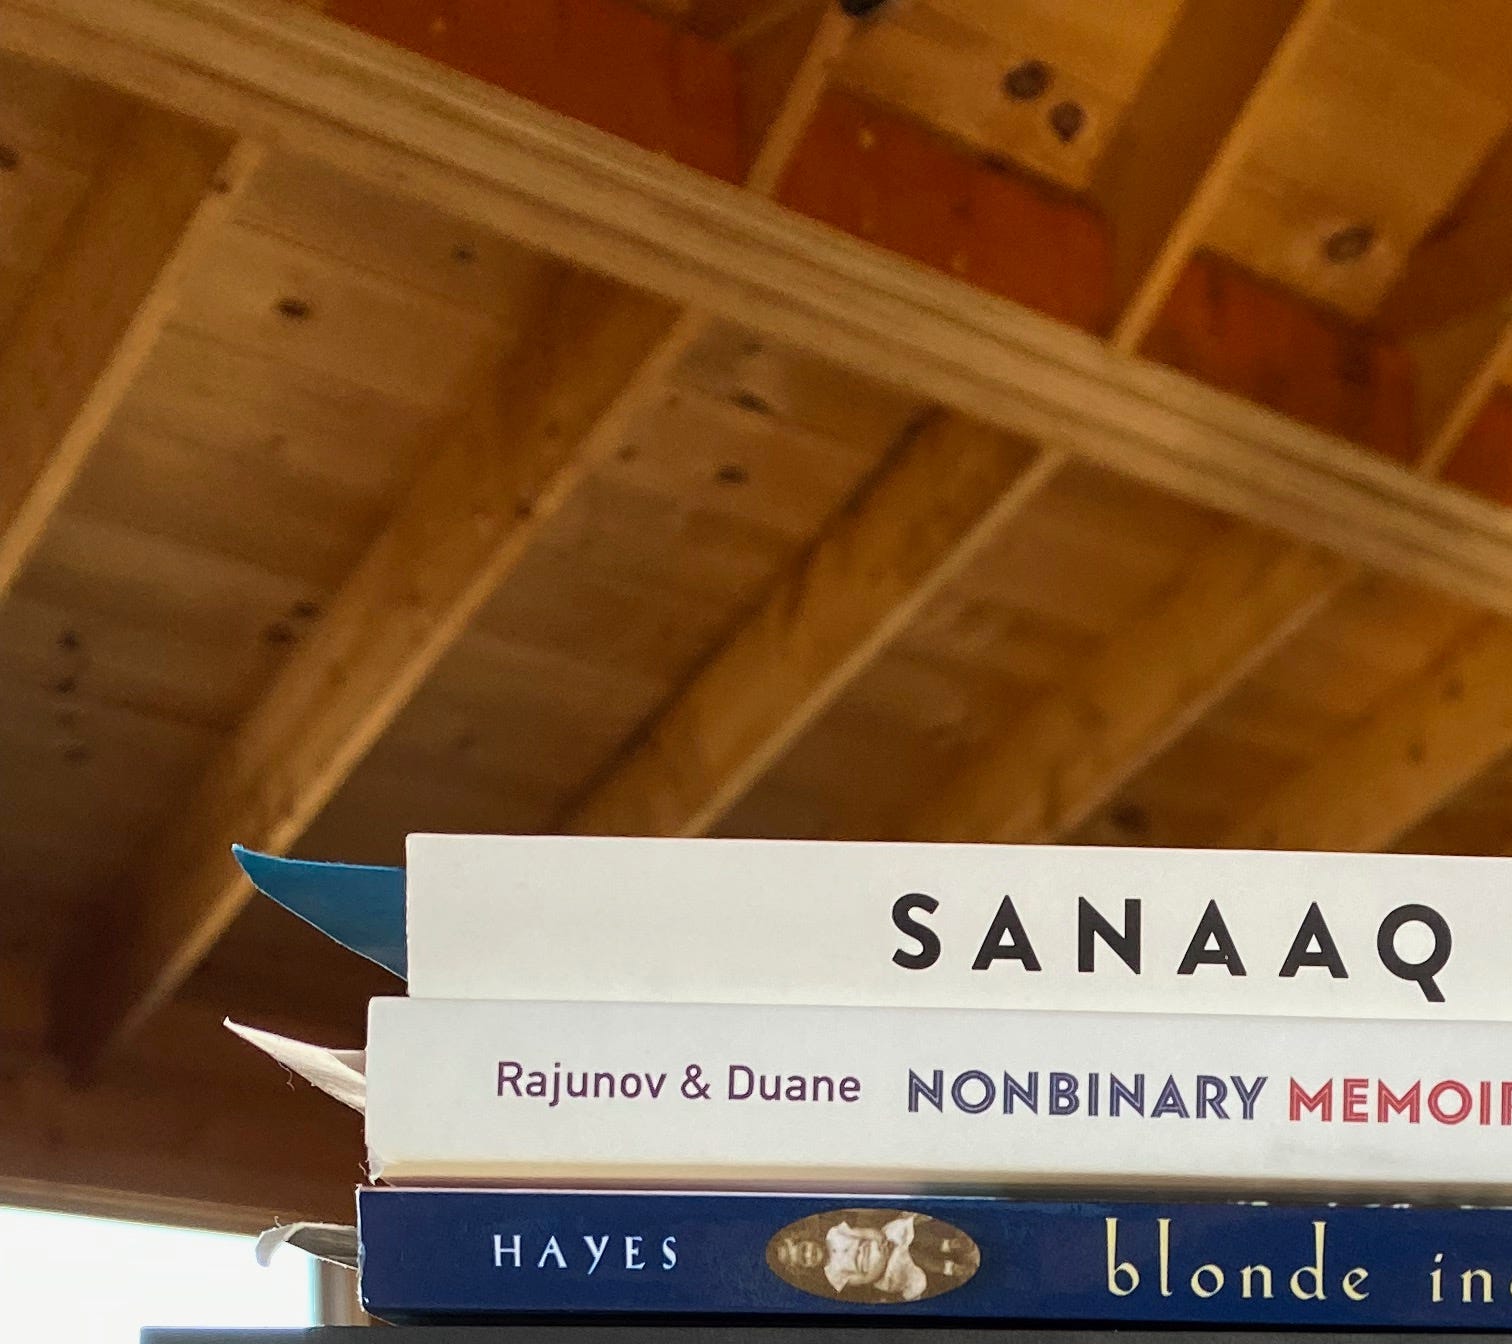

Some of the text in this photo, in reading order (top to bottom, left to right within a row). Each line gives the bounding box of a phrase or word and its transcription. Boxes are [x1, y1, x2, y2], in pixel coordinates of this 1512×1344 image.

[890, 889, 1453, 1003] SANAAQ
[496, 1060, 862, 1108] Rajunov & Duane
[907, 1069, 1269, 1121] NONBINARY
[493, 1234, 678, 1276] HAYES
[1104, 1216, 1370, 1303] blonde
